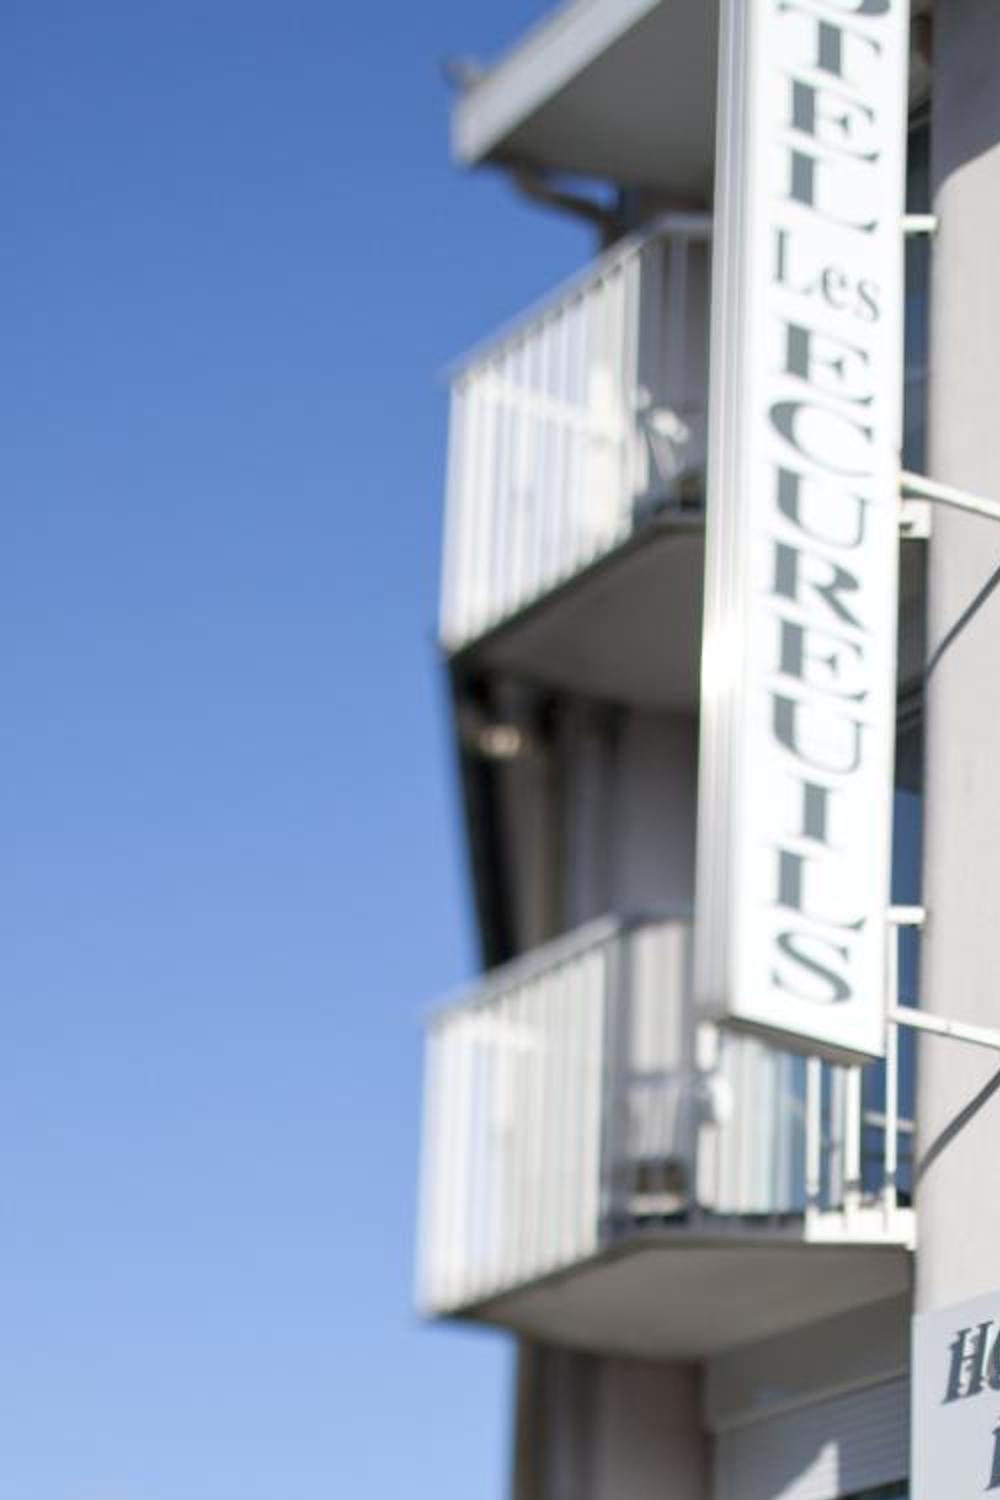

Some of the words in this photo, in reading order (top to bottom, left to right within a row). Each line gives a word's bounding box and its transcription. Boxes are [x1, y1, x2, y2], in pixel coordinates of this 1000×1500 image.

[774, 0, 892, 235] TEL
[770, 226, 882, 325] Les
[764, 314, 876, 1006] ECUREUILS
